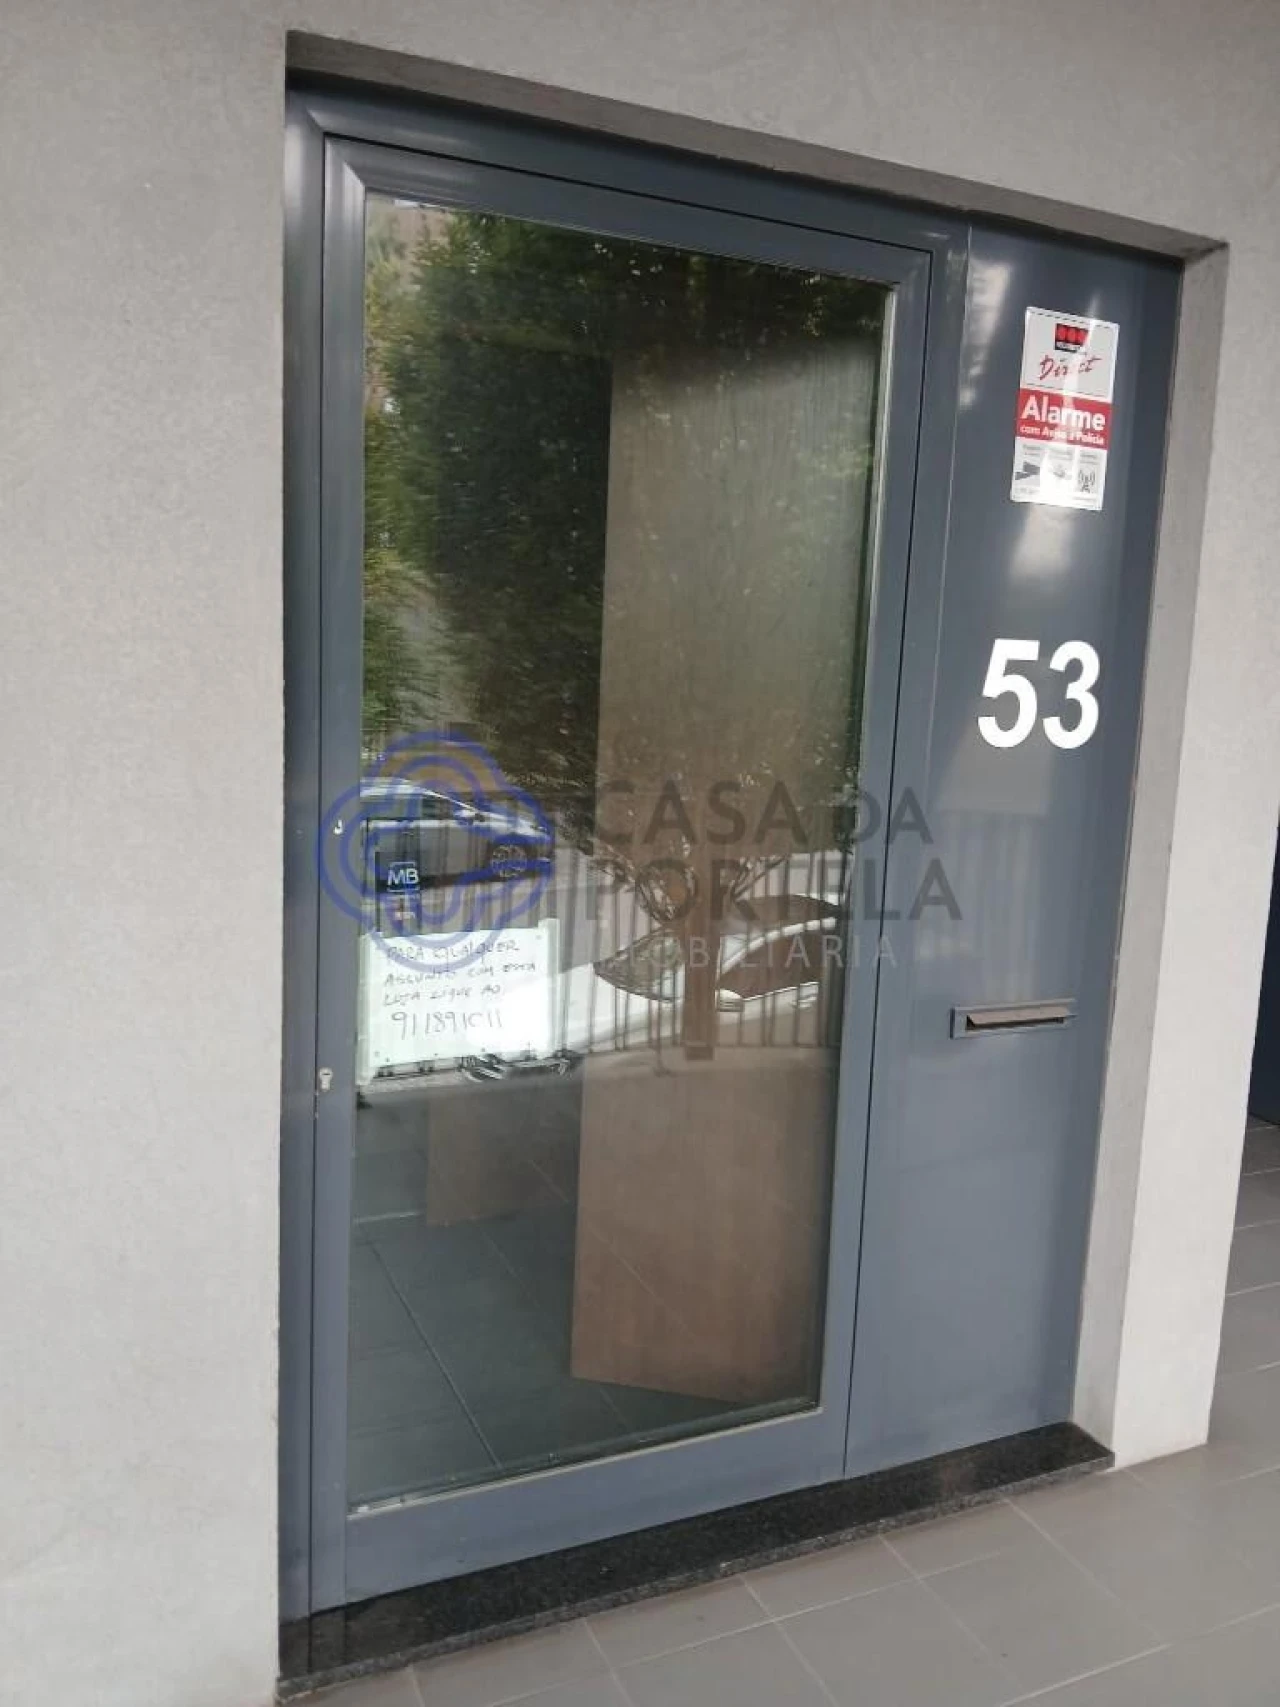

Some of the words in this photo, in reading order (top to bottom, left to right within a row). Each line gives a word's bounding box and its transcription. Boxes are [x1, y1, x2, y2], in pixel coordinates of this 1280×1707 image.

[1021, 394, 1106, 431] Alarme
[977, 638, 1100, 749] 53
[387, 867, 420, 887] MB
